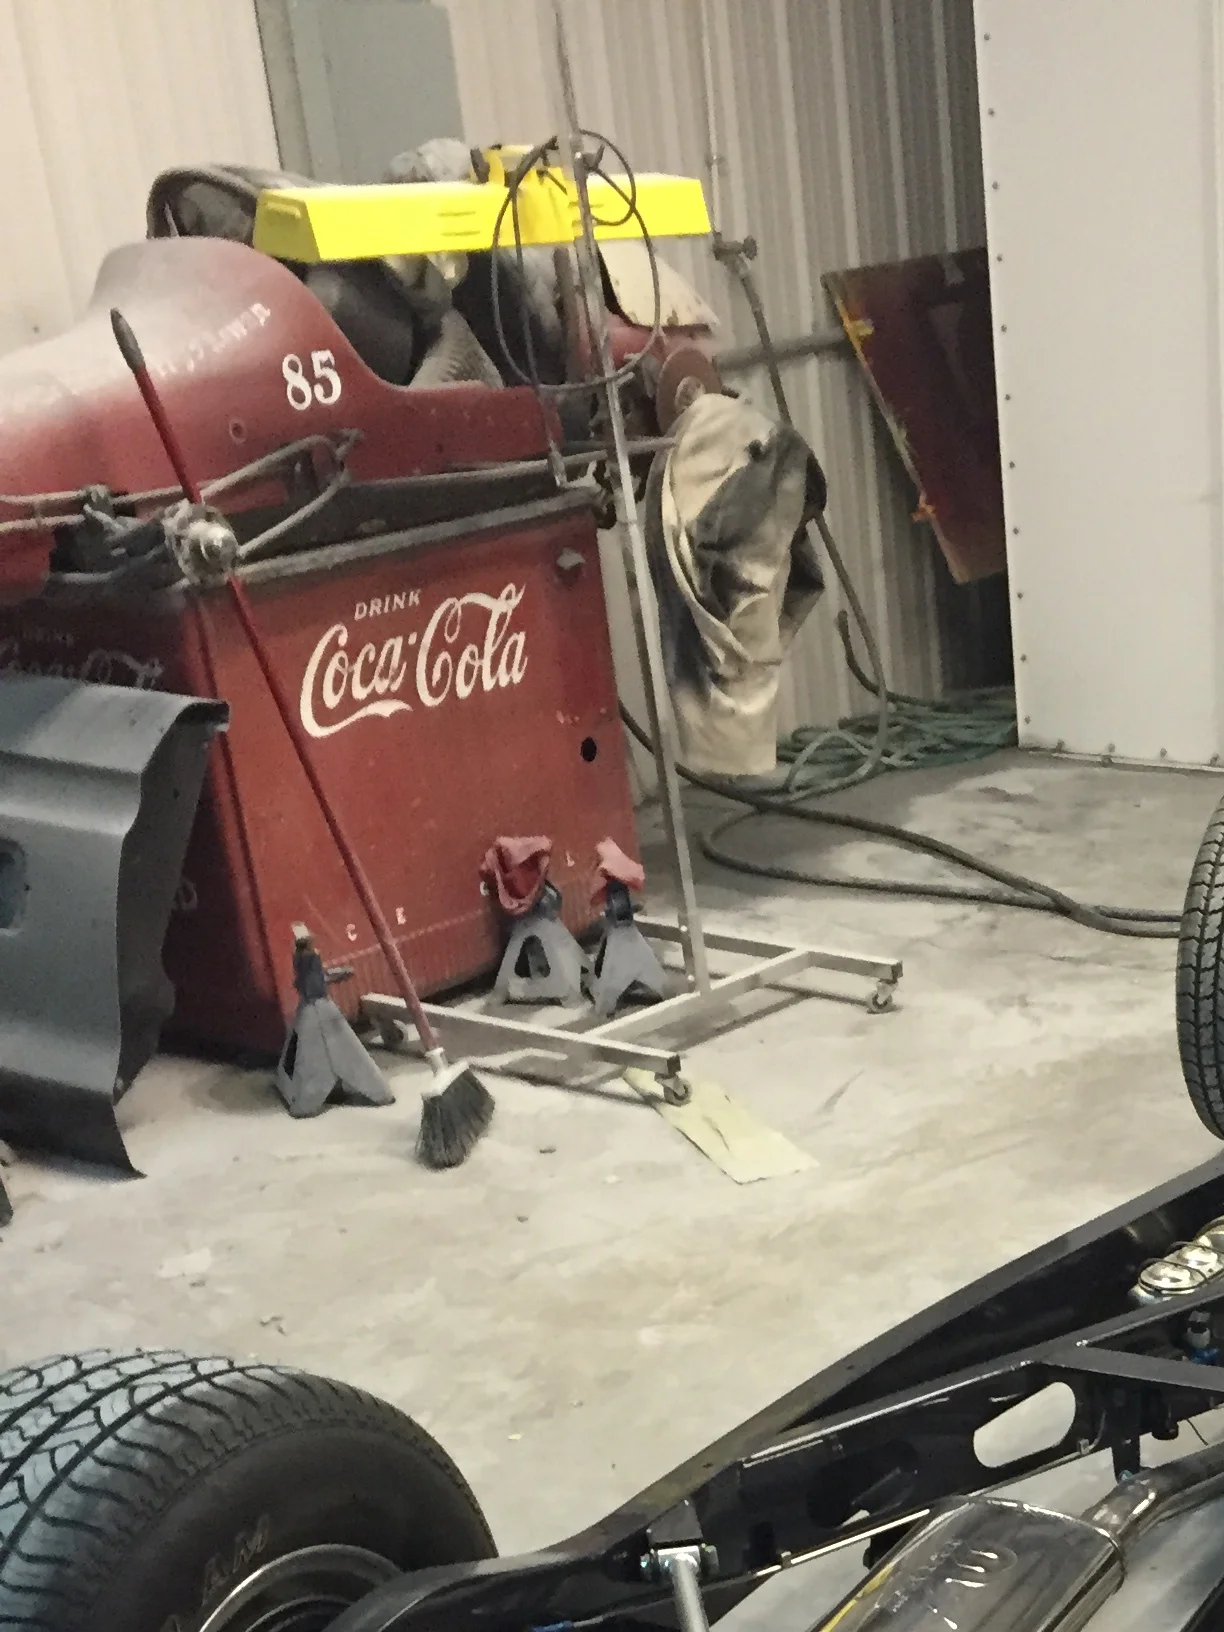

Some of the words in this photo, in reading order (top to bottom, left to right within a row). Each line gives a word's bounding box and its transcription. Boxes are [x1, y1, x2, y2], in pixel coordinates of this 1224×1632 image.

[281, 349, 342, 411] 85
[353, 588, 423, 622] DRINK
[299, 581, 529, 739] Coca-Cola
